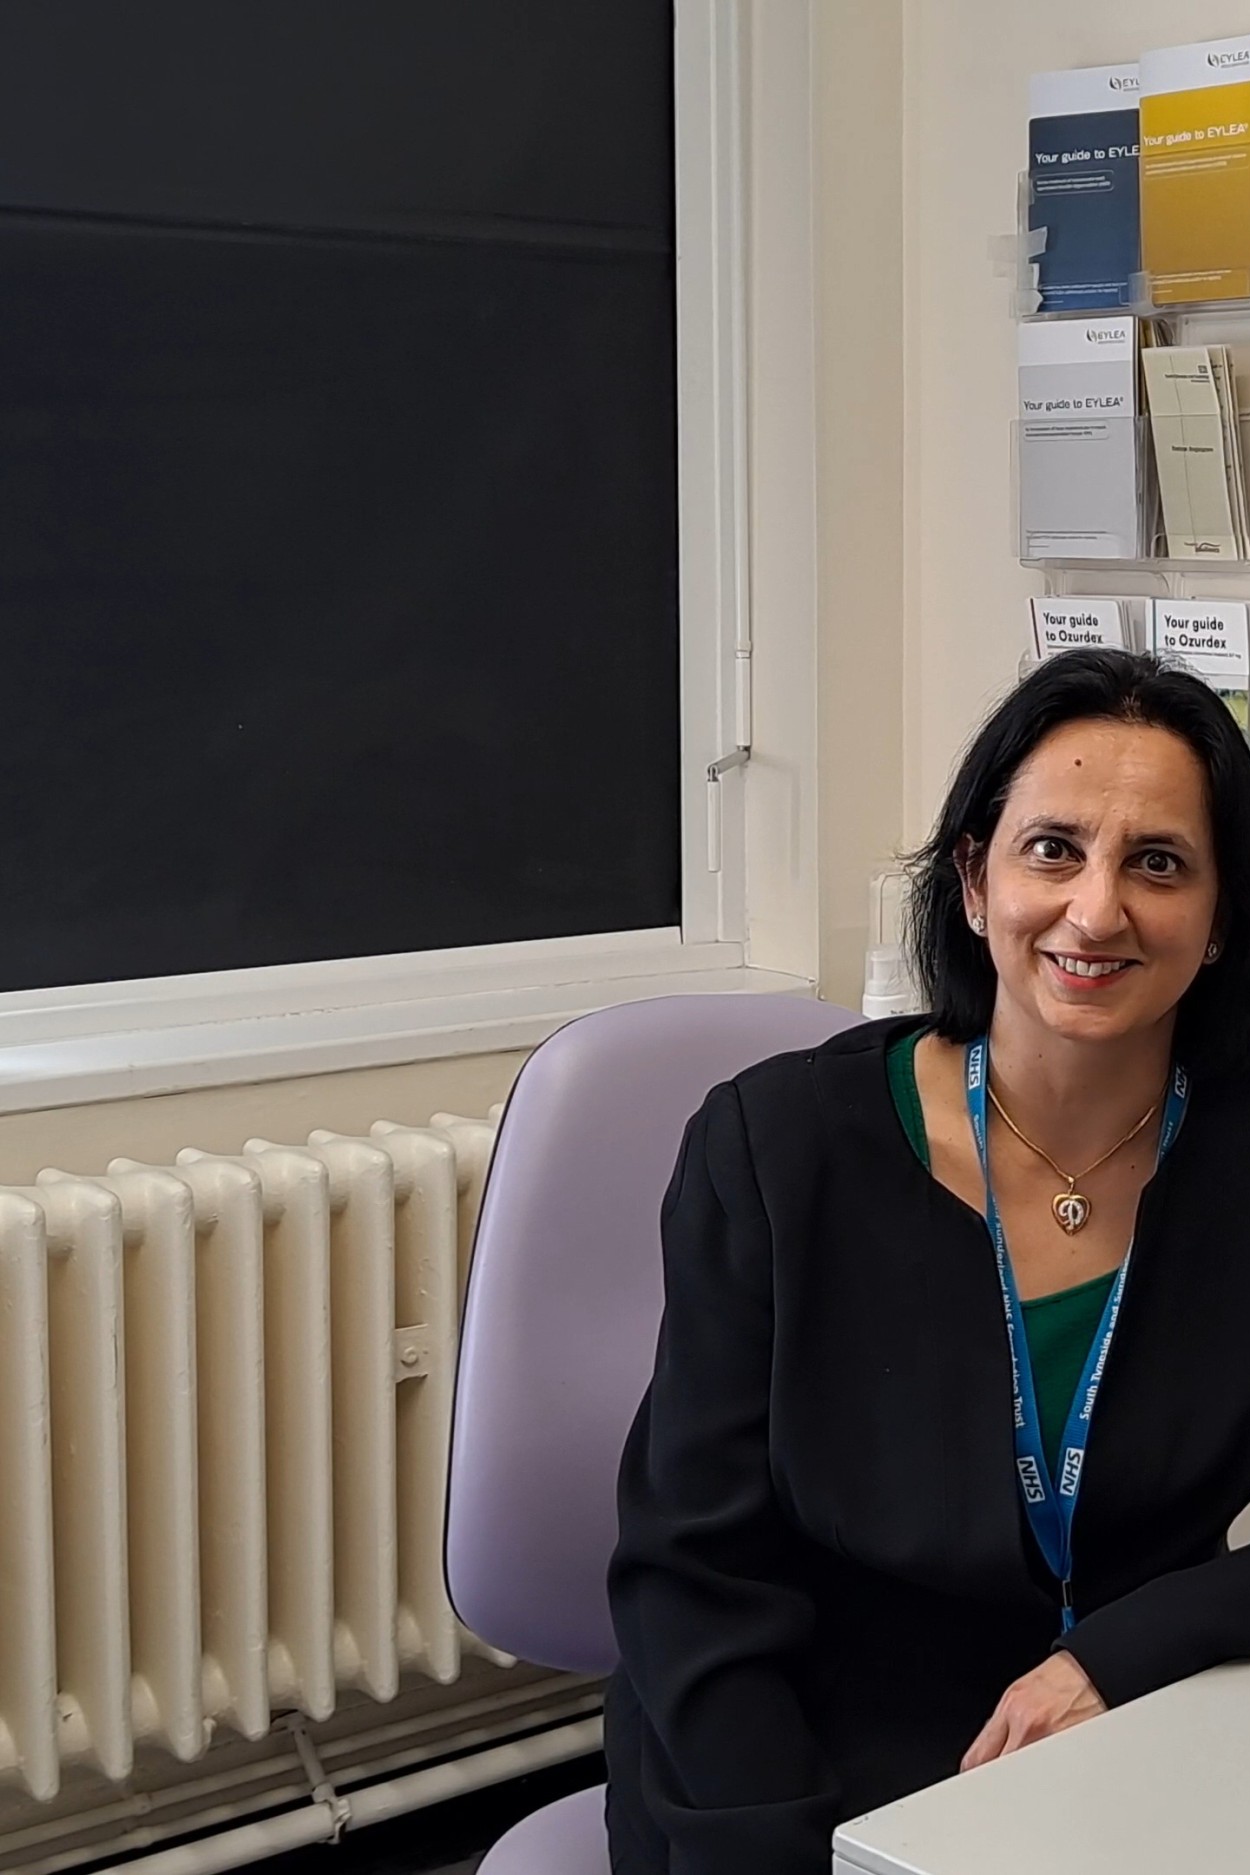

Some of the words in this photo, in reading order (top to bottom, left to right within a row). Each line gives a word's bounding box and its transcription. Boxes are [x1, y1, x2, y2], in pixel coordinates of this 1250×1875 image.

[1143, 135, 1164, 146] Your
[1166, 131, 1191, 146] guide
[1195, 130, 1204, 140] to
[1035, 153, 1059, 164] Your
[1061, 149, 1091, 164] guide
[1094, 149, 1105, 159] to
[1108, 145, 1139, 158] EYLE
[1024, 401, 1043, 411] Your
[1045, 399, 1070, 412] guide
[1073, 399, 1083, 409] to
[1043, 612, 1067, 625] Your
[1069, 612, 1099, 628] guide
[1164, 615, 1190, 629] Your
[1192, 616, 1224, 632] guide
[1045, 630, 1056, 641] to
[1058, 630, 1103, 643] Ozurdex
[1164, 634, 1176, 647] to
[1178, 633, 1227, 649] Ozurdex
[970, 1048, 981, 1087] NHS
[1079, 1385, 1098, 1421] South
[1013, 1396, 1026, 1429] Trust
[1018, 1460, 1044, 1500] NHS
[1062, 1450, 1081, 1494] NHS
